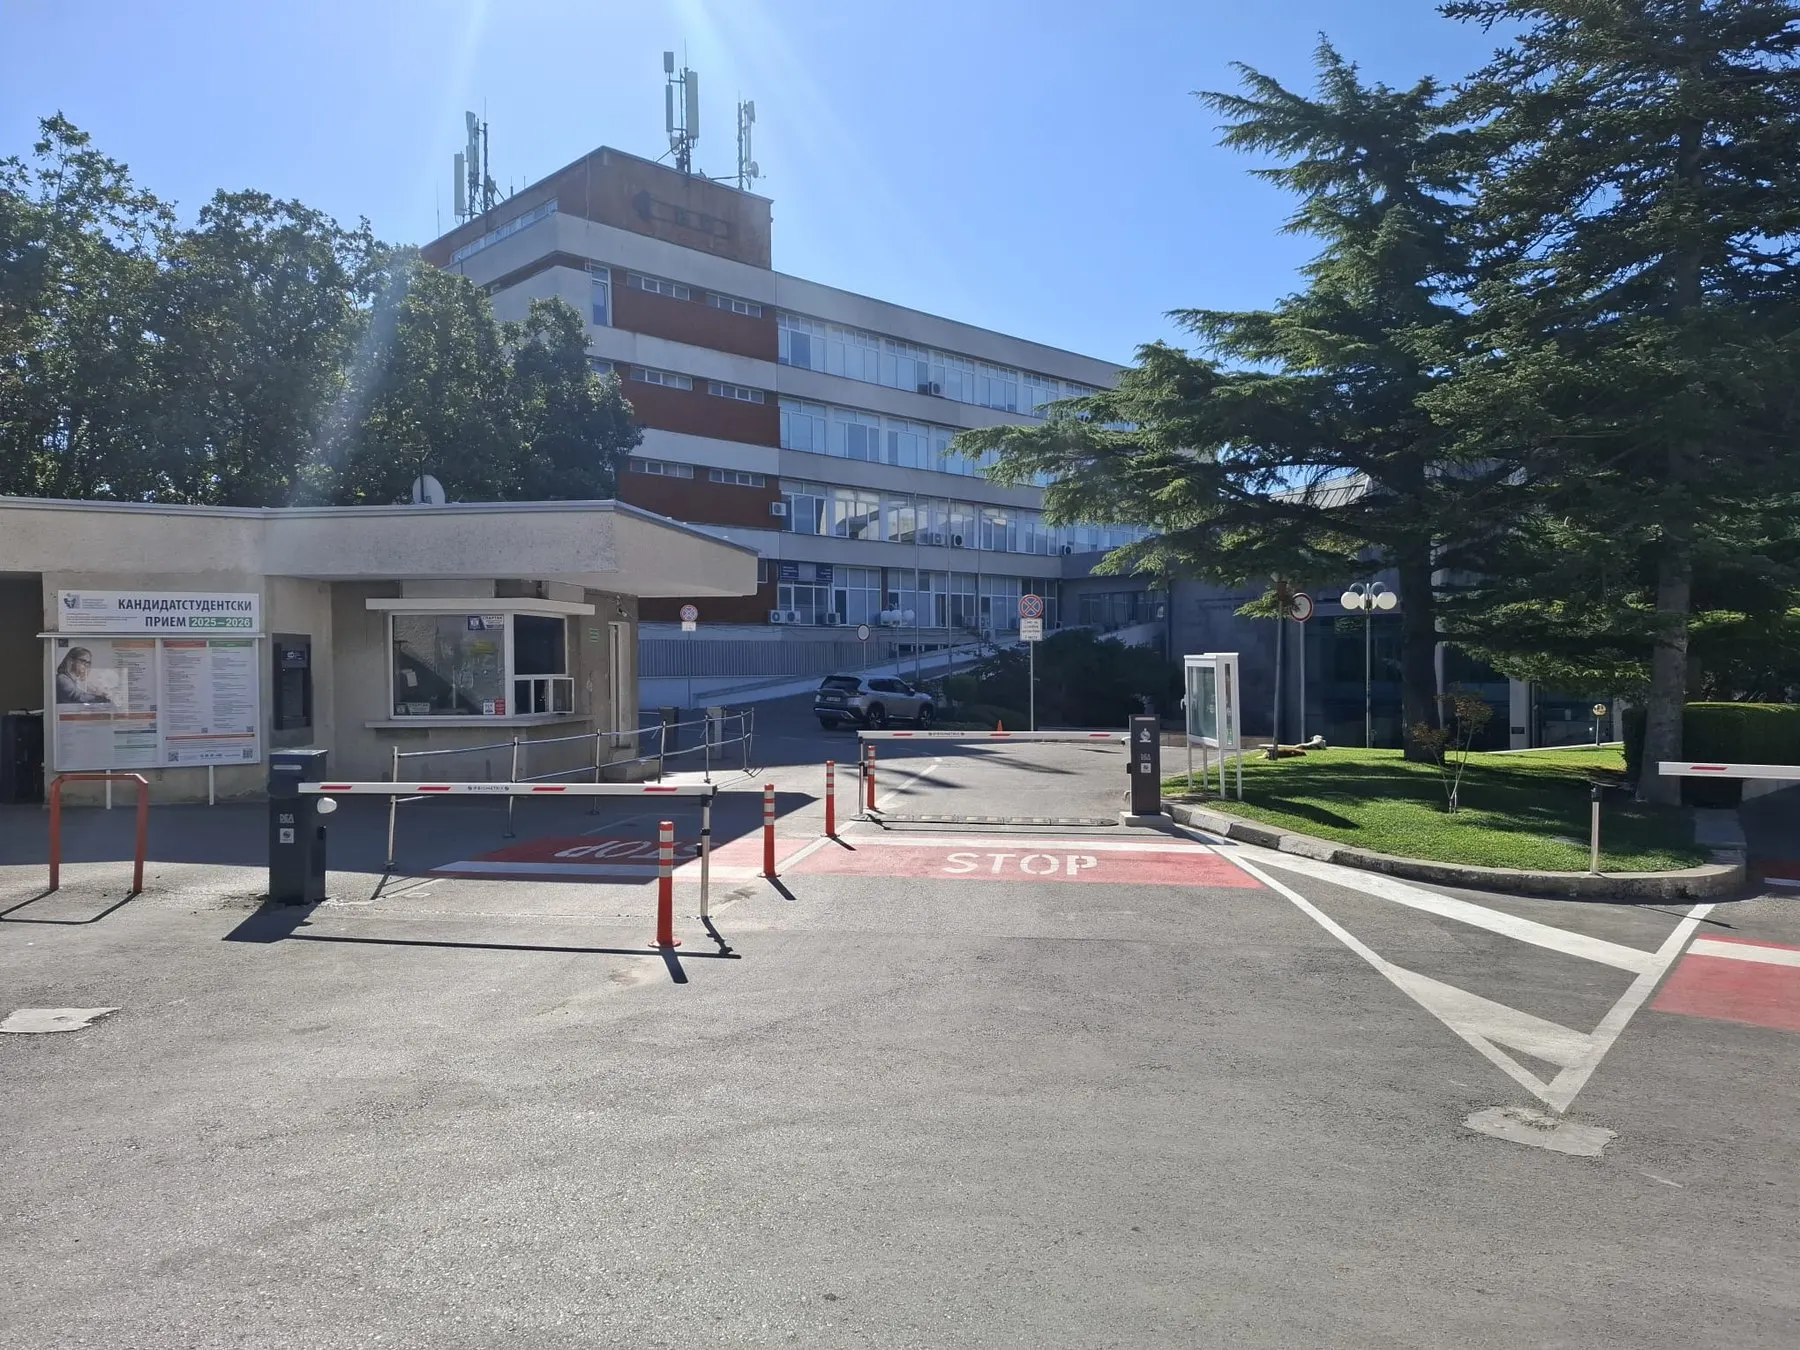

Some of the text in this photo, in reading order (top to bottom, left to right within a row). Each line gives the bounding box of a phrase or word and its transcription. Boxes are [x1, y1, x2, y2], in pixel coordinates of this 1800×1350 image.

[118, 599, 252, 612] КАНДИДАТСТУДЕНТСКИ
[145, 616, 186, 627] ПРИЕМ
[942, 852, 1098, 876] STOP
